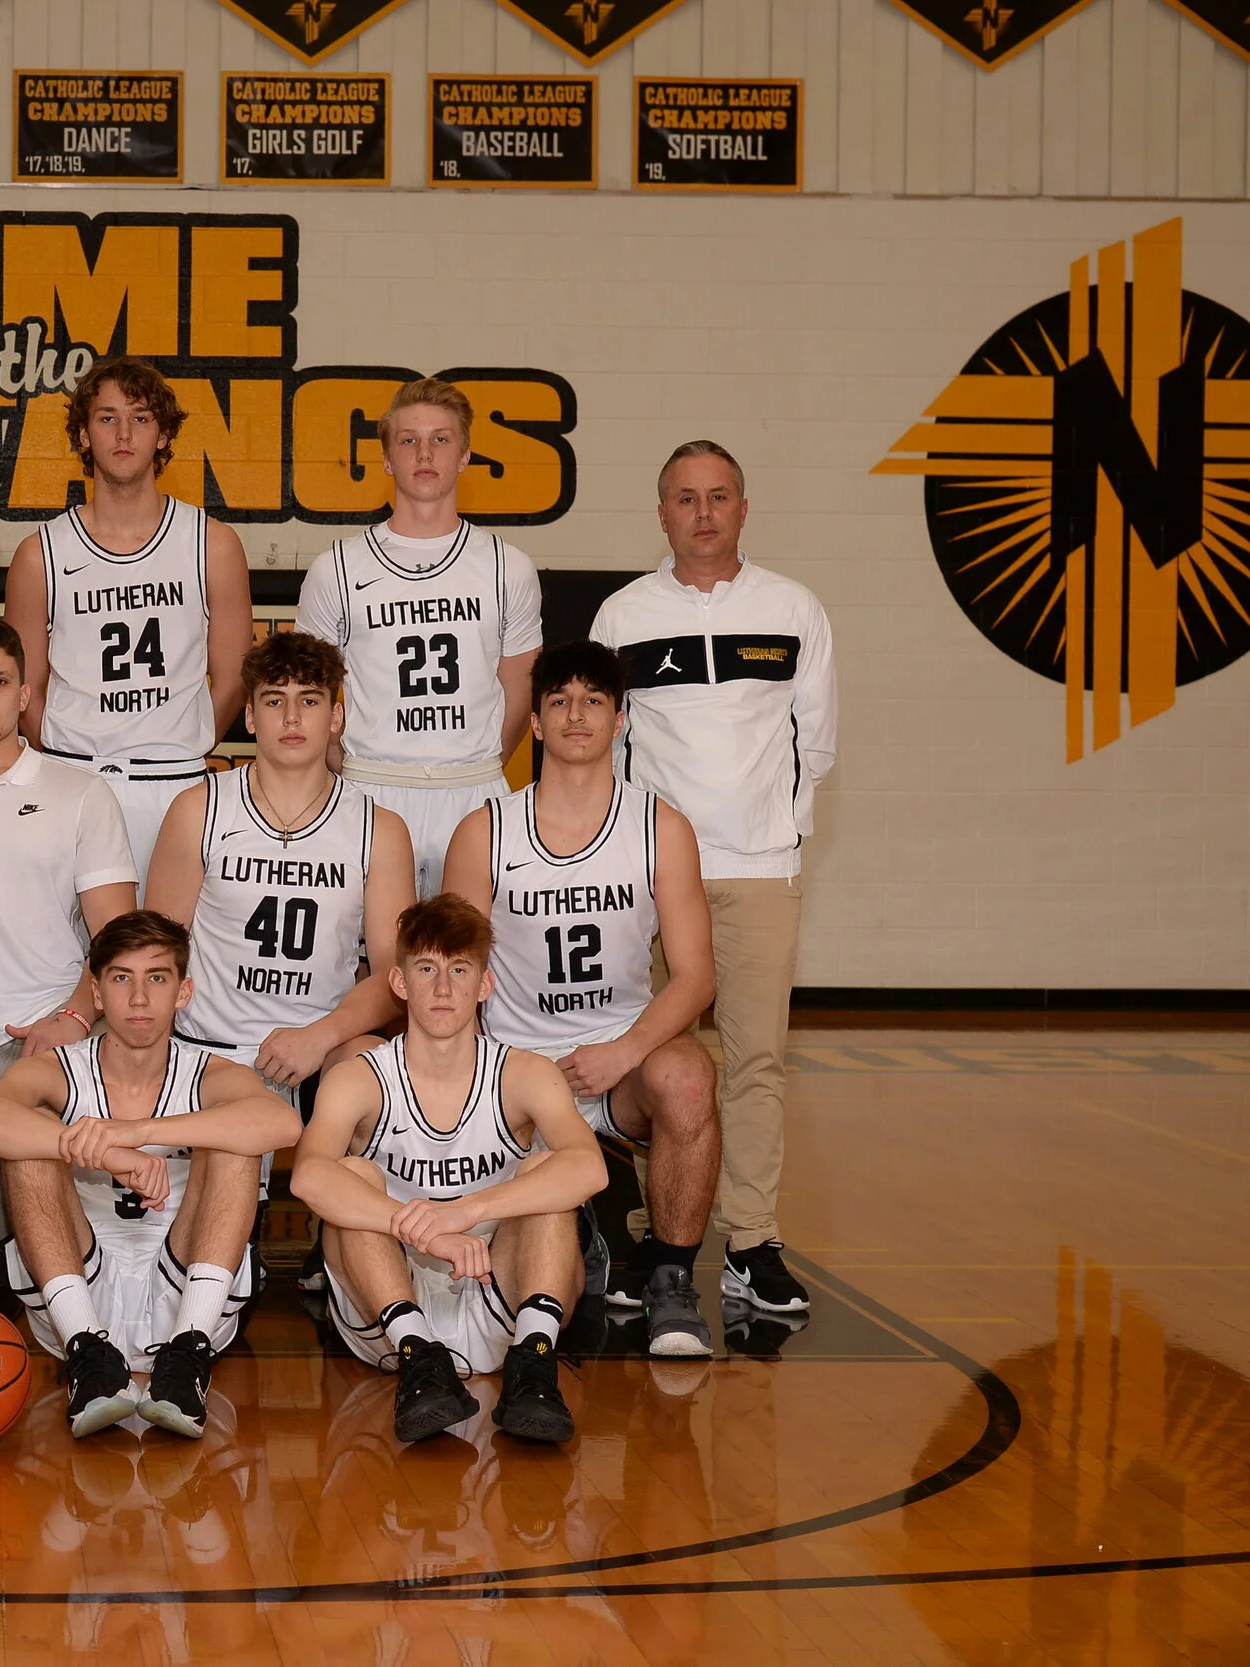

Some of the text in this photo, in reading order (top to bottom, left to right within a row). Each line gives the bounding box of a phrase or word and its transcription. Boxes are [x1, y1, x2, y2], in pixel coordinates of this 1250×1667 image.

[25, 80, 172, 99] CATHOLIC LEAGUE
[232, 81, 379, 101] CATHOLIC LEAGUE
[439, 84, 586, 104] CATHOLIC LEAGUE
[645, 87, 791, 107] CATHOLIC LEAGUE
[28, 102, 168, 122] CHAMPIONS
[235, 104, 375, 124] CHAMPIONS
[442, 106, 582, 127] CHAMPIONS
[648, 109, 787, 130] CHAMPIONS
[63, 127, 132, 153] DANCE
[248, 129, 364, 155] GIRLS GOLF
[462, 131, 564, 158] BASEBALL
[668, 134, 768, 161] SOFTBALL
[0, 322, 95, 395] the
[73, 581, 184, 616] LUTHERAN
[366, 597, 481, 629] LUTHERAN
[100, 617, 166, 683] 24
[396, 633, 460, 698] 23
[100, 686, 170, 713] NORTH
[396, 705, 466, 733] NORTH
[221, 856, 345, 889] LUTHERAN
[508, 884, 634, 917] LUTHERAN
[244, 895, 319, 961] 40
[544, 923, 604, 984] 12
[237, 964, 312, 997] NORTH
[538, 987, 614, 1016] NORTH
[387, 1149, 506, 1188] LUTHERAN
